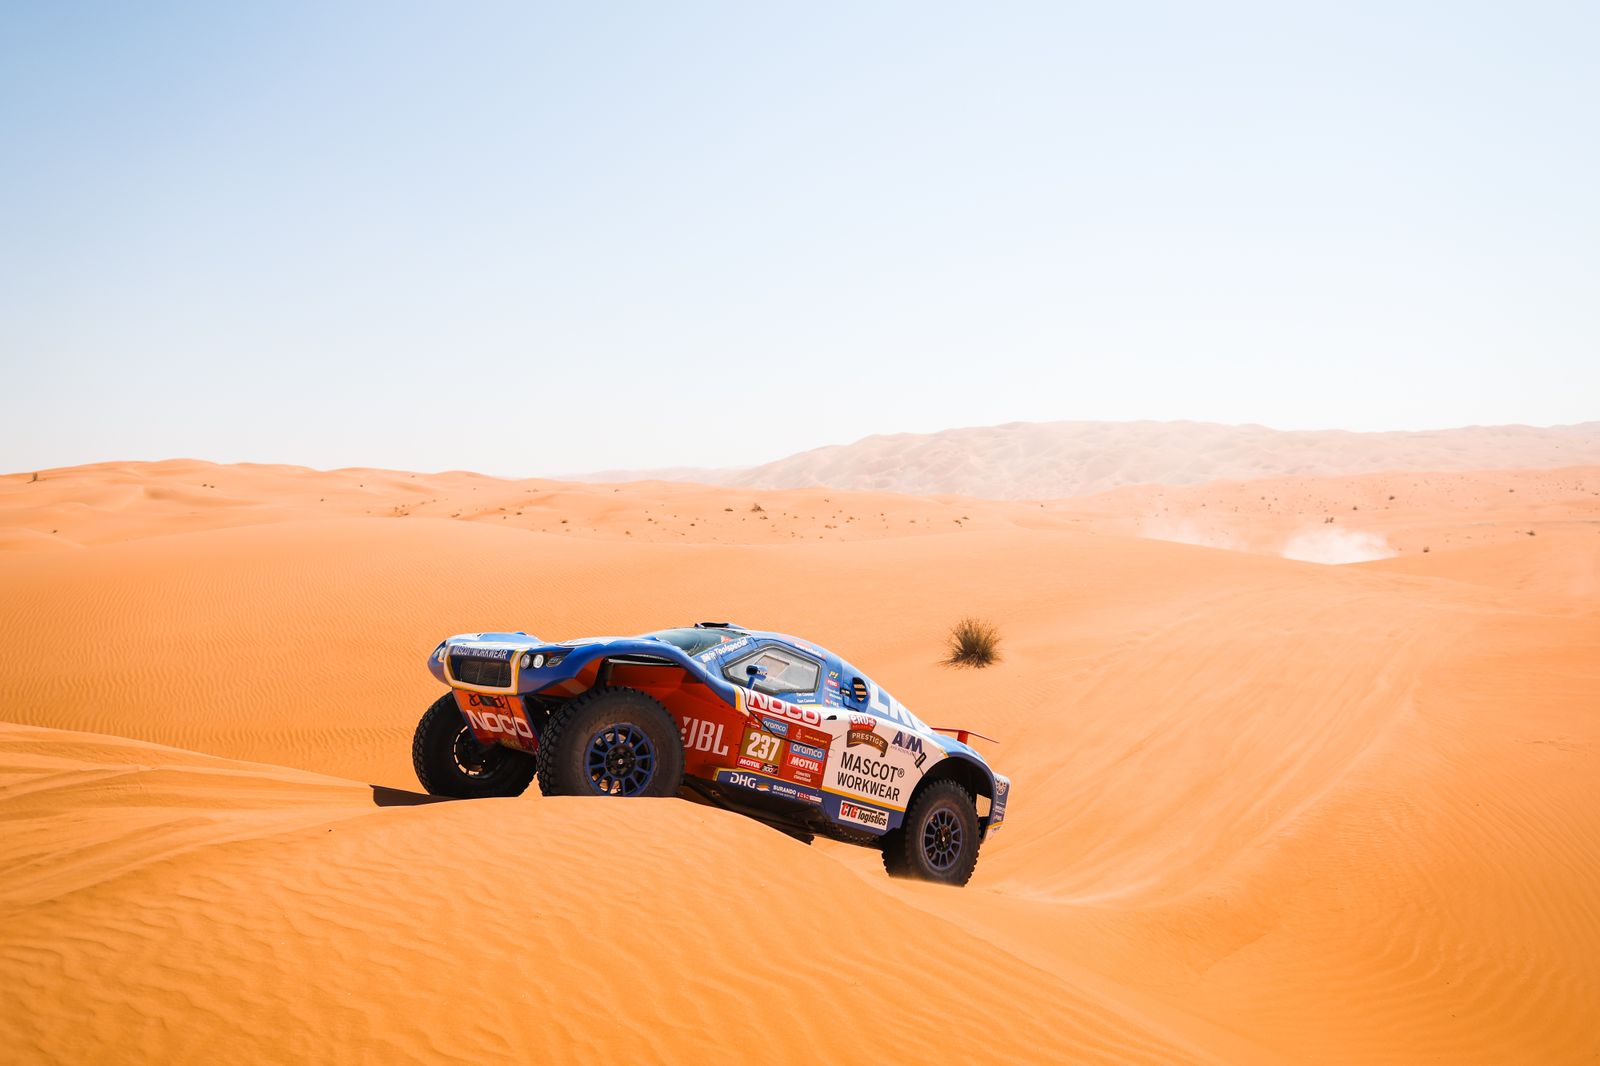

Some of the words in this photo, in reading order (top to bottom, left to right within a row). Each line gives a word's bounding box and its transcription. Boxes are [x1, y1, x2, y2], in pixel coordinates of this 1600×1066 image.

[749, 691, 821, 726] NOCO
[466, 709, 533, 738] NOCO
[763, 720, 787, 733] aramco
[683, 718, 729, 757] JBL
[851, 732, 884, 748] PRESTIGE
[745, 731, 781, 762] 237
[792, 743, 823, 759] aramco
[739, 758, 761, 769] MOTUL
[790, 756, 819, 772] MOTUL
[729, 772, 757, 789] DHG
[837, 771, 900, 802] WORKWEAR
[773, 784, 797, 796] BURANDO
[841, 803, 858, 818] CTG
[858, 810, 887, 826] logistics
